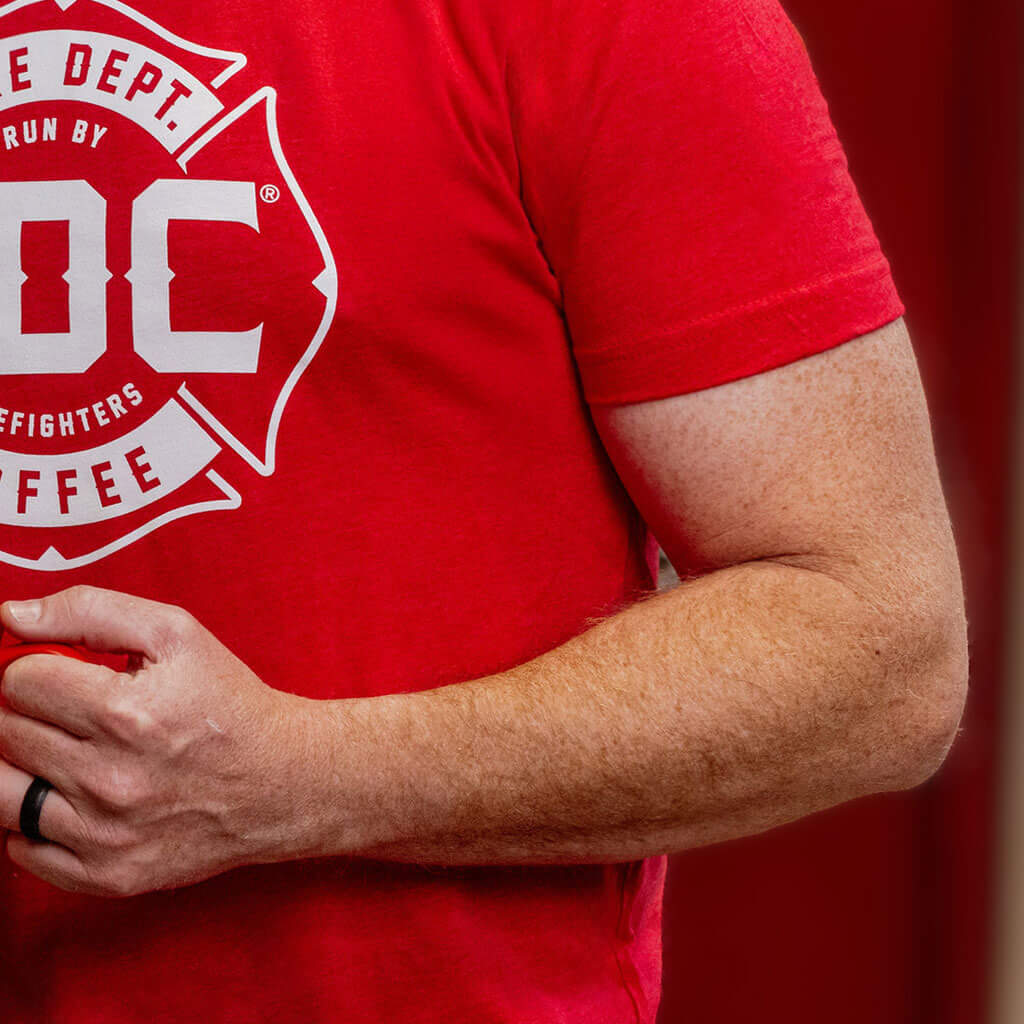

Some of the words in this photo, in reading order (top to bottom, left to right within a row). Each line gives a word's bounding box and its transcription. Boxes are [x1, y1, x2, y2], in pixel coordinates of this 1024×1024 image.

[63, 43, 192, 131] DEPT.
[3, 118, 56, 149] RUN
[72, 120, 107, 149] BY
